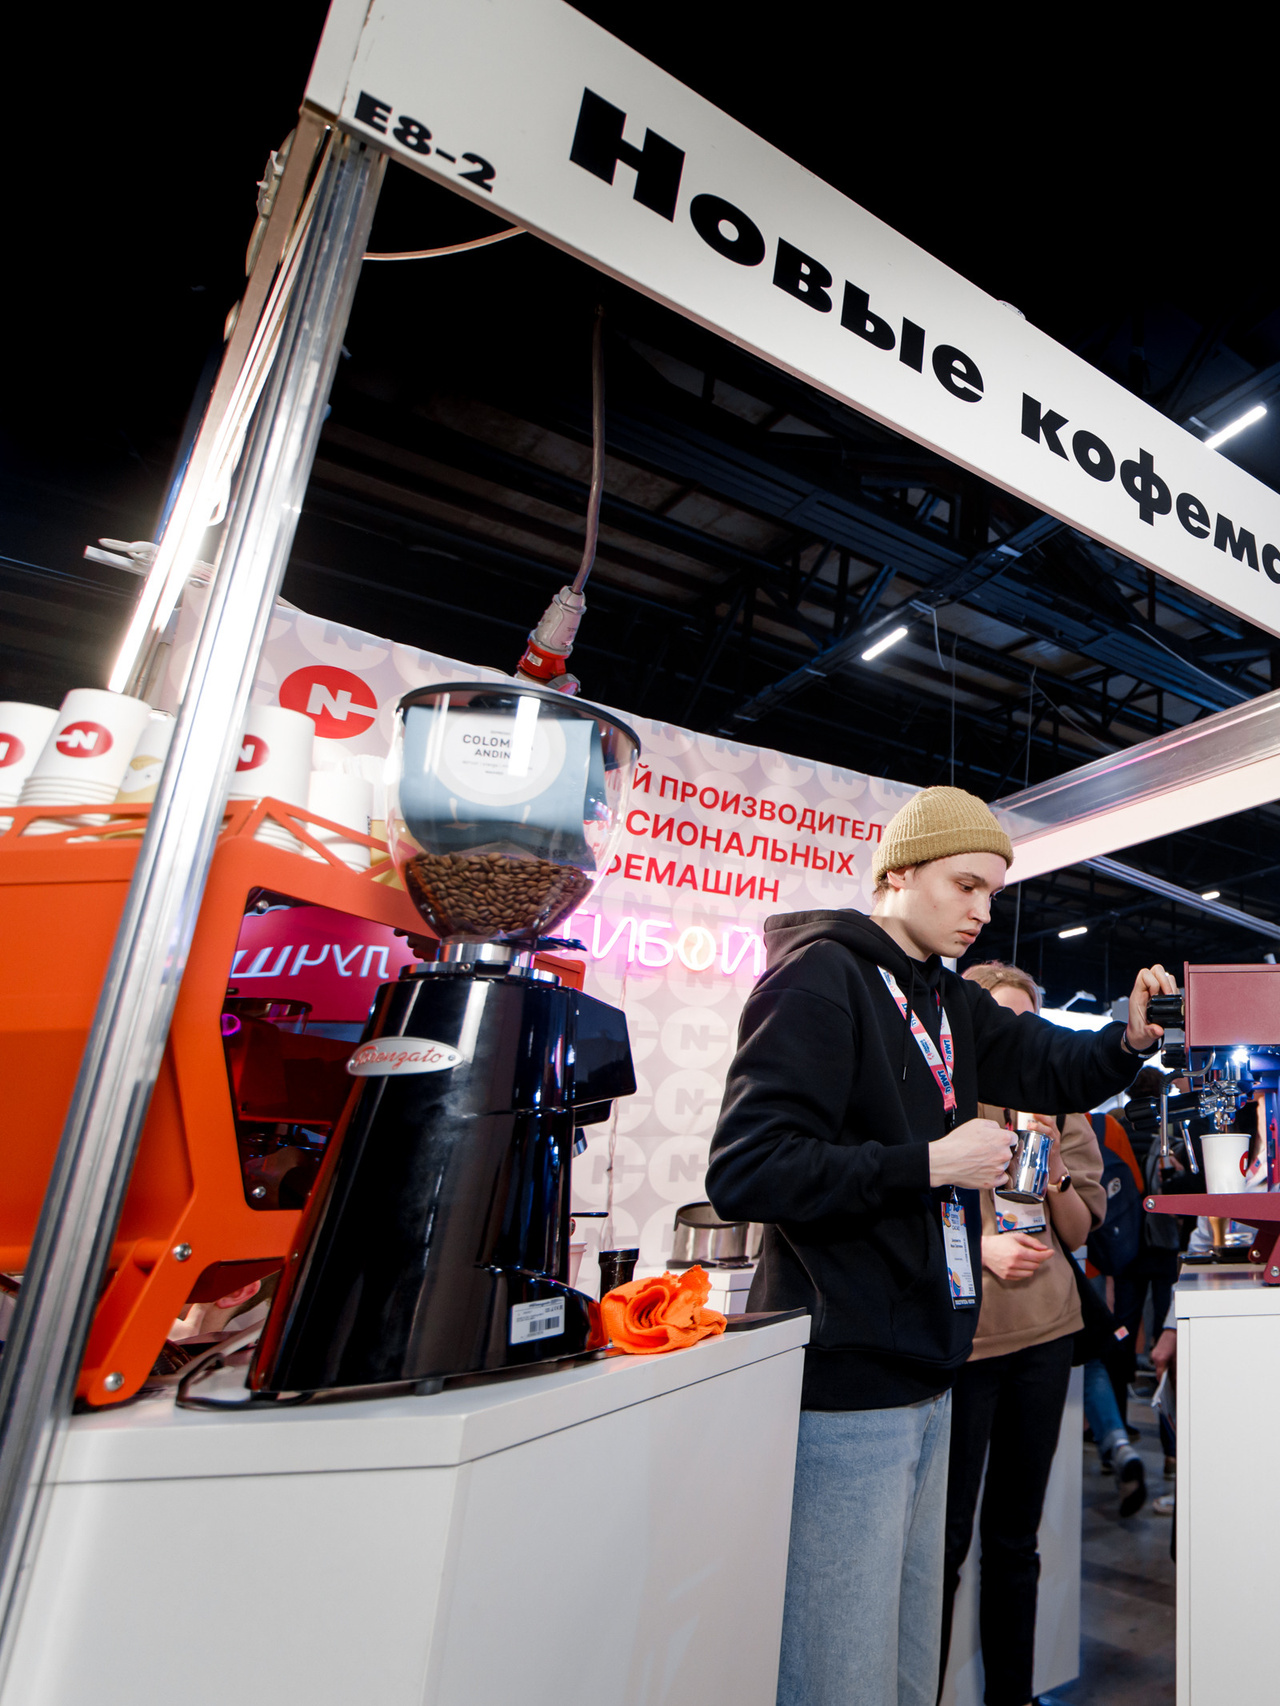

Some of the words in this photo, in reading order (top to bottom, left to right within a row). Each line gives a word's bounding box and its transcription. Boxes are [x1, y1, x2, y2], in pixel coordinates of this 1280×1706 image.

[569, 86, 985, 404] Новые
[659, 775, 885, 843] ПРОИЗВОДИТЕЛ
[943, 1039, 953, 1057] BWT
[937, 1069, 951, 1088] BWT
